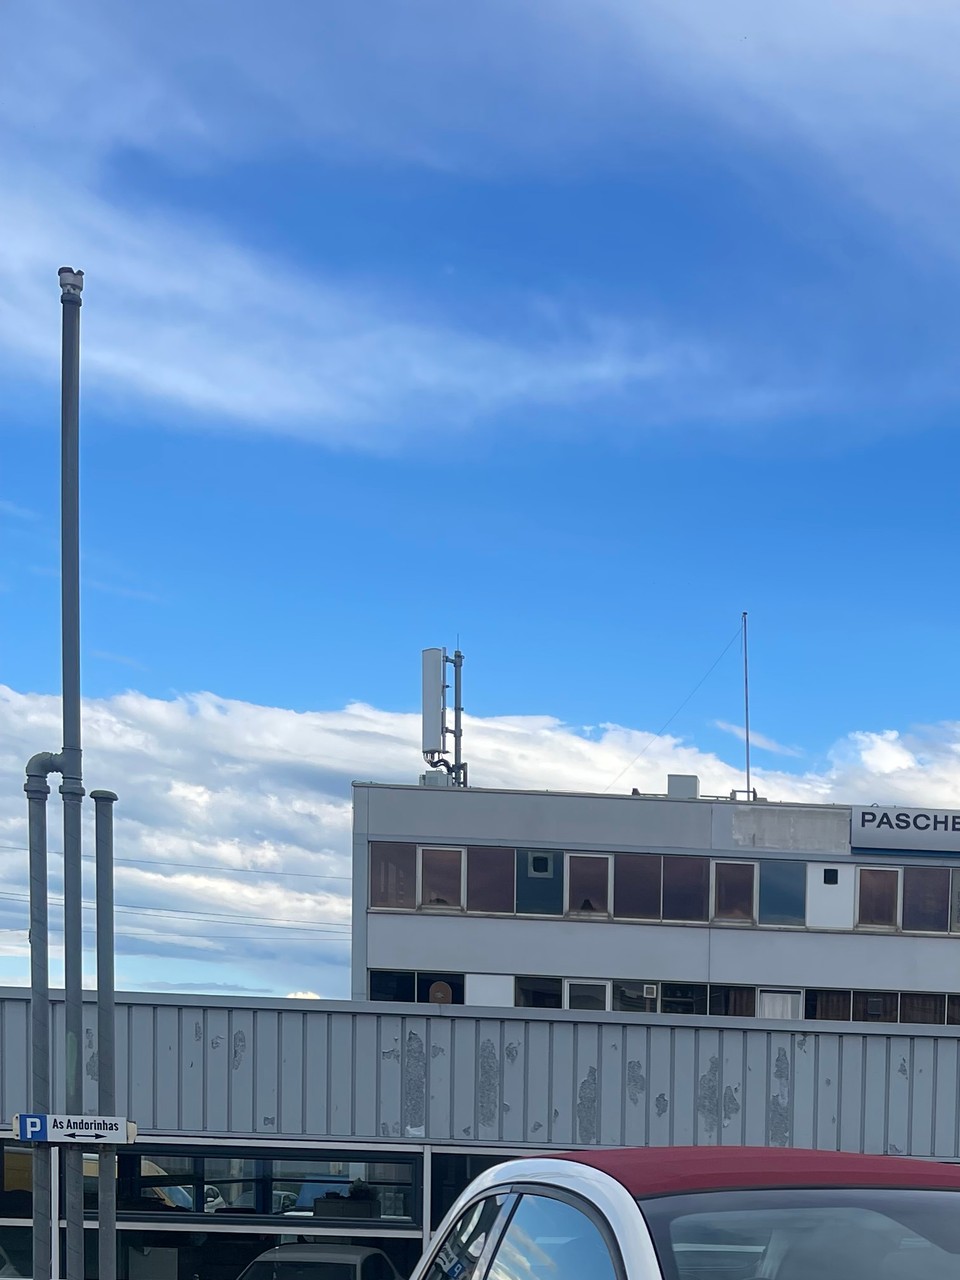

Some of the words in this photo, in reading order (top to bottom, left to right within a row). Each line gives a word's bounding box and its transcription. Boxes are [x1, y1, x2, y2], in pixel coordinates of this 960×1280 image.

[26, 1117, 41, 1138] P
[52, 1118, 64, 1129] As
[66, 1119, 119, 1132] Andorinhas
